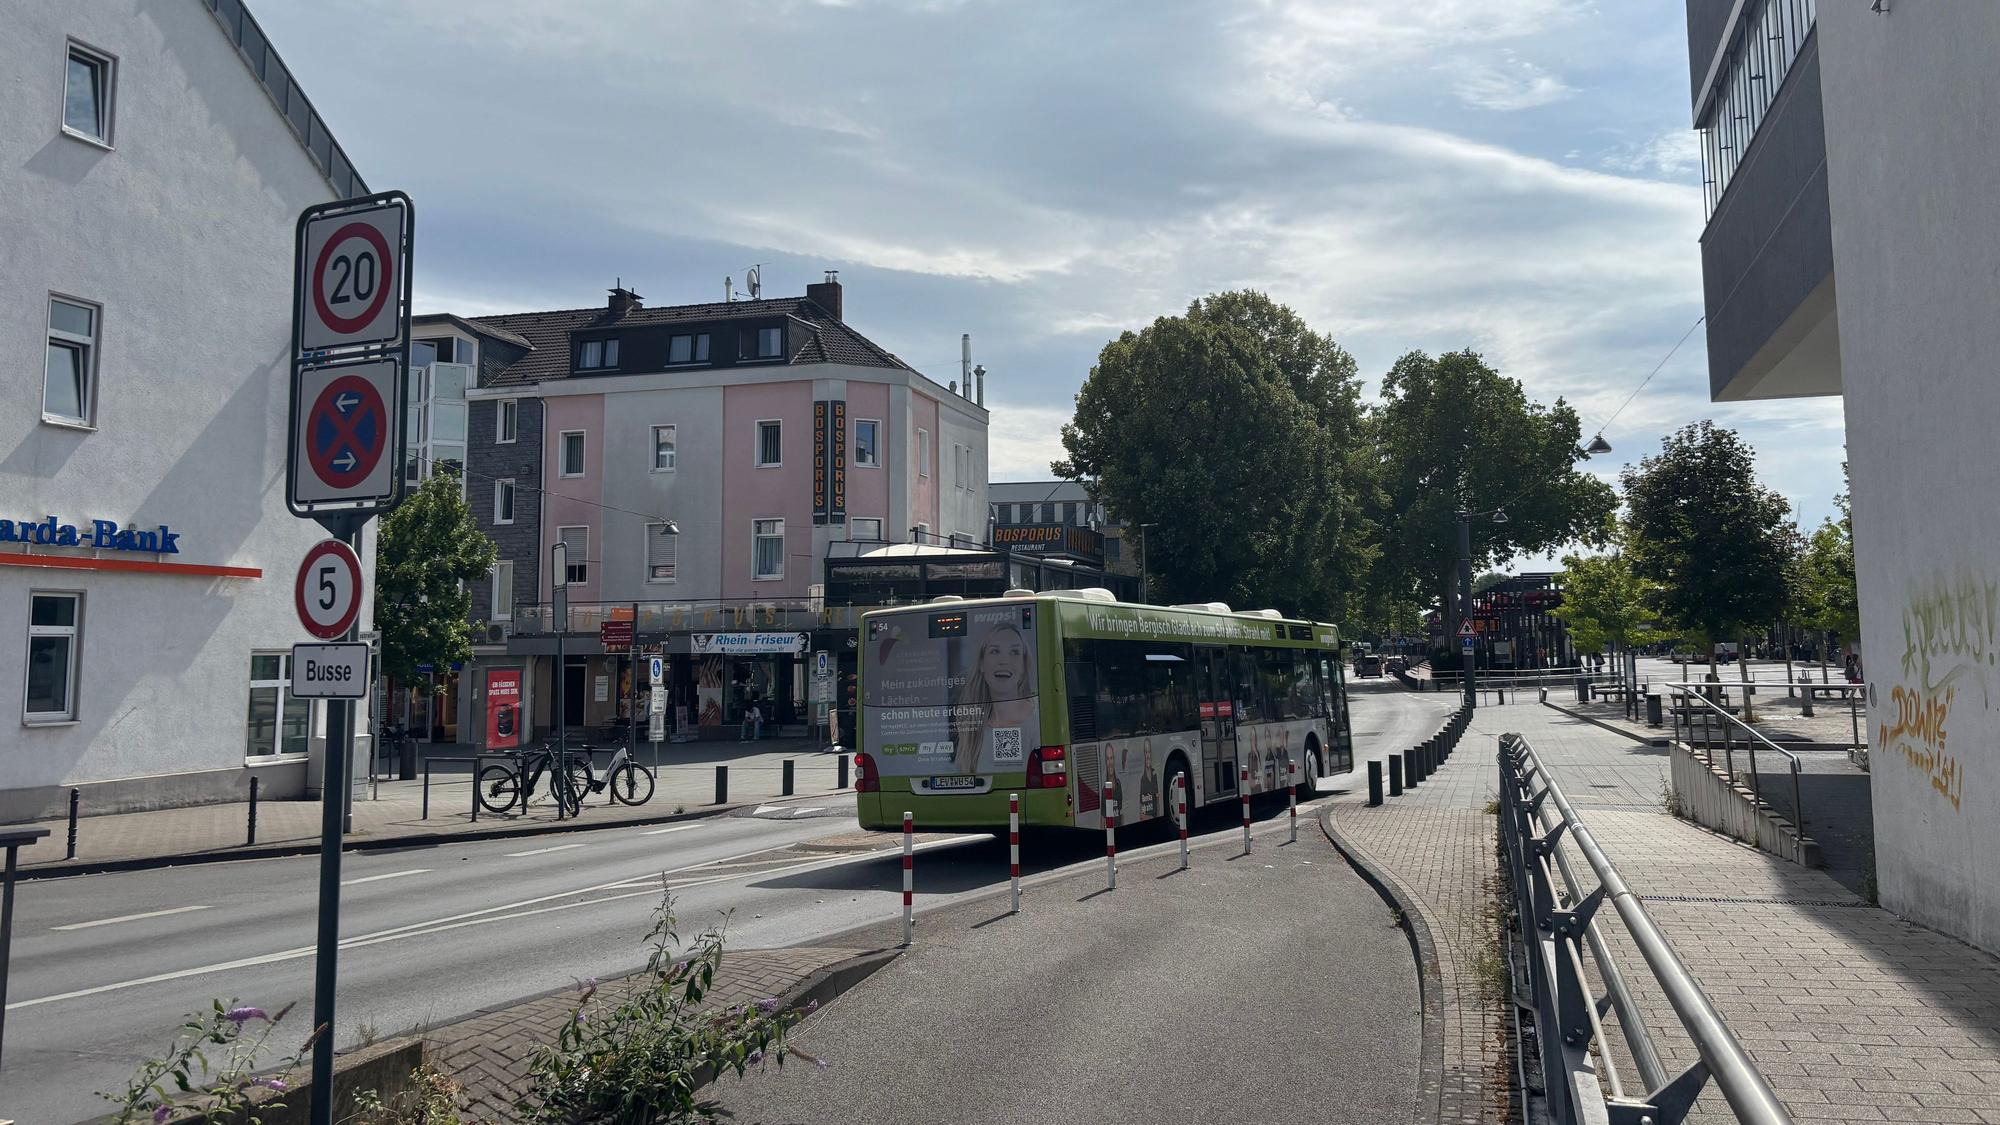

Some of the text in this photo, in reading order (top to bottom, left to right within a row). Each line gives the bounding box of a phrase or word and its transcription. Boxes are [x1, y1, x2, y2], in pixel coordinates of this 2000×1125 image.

[330, 251, 375, 304] 20
[815, 404, 824, 507] BOSPORUS
[835, 404, 844, 508] BOSPORUS
[0, 515, 181, 554] arda-Bank
[995, 527, 1062, 542] BOSPORUS
[1011, 543, 1046, 552] RESTAURANT
[318, 566, 337, 611] 5
[974, 607, 1017, 625] wupsi
[878, 622, 888, 632] 54
[1088, 612, 1105, 631] Wir
[1106, 615, 1138, 637] bringen
[1138, 616, 1172, 639] Bergisch
[1171, 618, 1203, 637] Gladbach
[715, 633, 796, 645] Rhein Friseur
[306, 659, 352, 682] Busse
[881, 675, 967, 690] Mein zukünftiges
[881, 694, 921, 706] Lächeln
[881, 705, 985, 721] schon heute erleben.
[936, 777, 950, 787] LEV
[964, 776, 974, 786] 54
